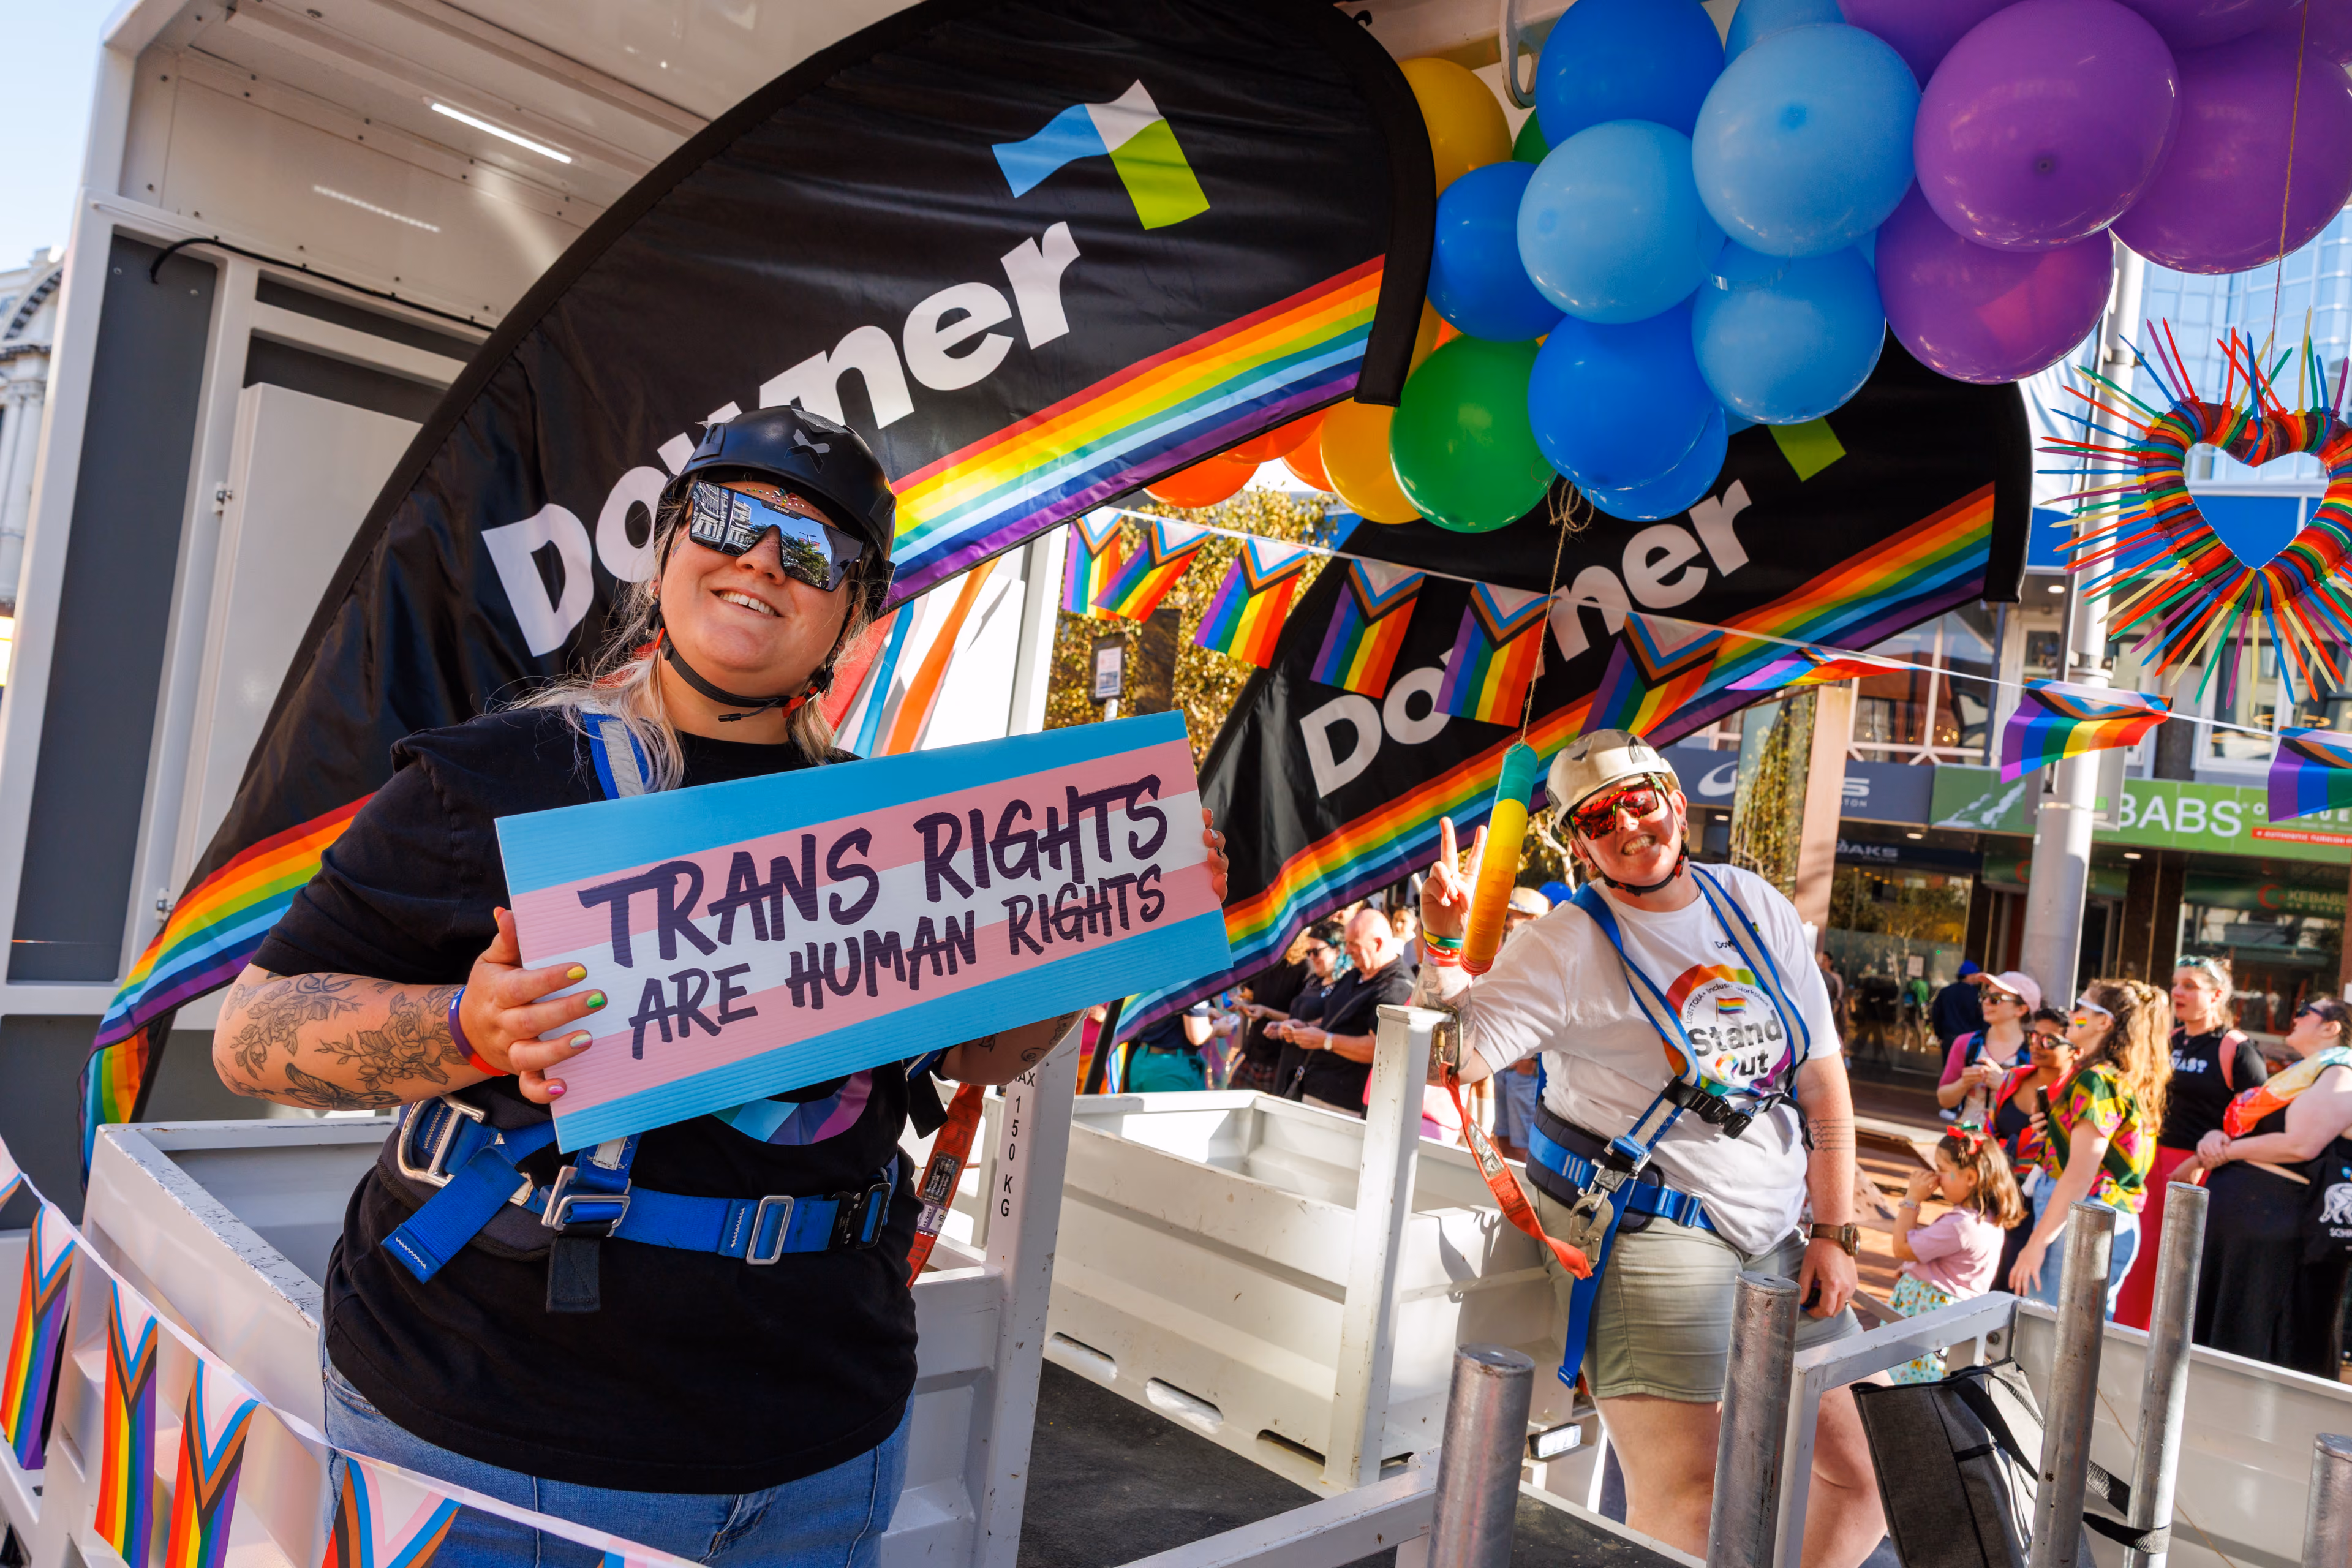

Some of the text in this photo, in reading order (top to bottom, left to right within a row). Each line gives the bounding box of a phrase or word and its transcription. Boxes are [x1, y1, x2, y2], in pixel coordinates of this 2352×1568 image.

[481, 221, 1081, 657] Doner
[1299, 478, 1752, 799] Doner
[576, 773, 1169, 968] TRANS RIGHTS
[2120, 793, 2242, 837] BABS
[628, 864, 1166, 1060] ARE HUMAN RIGHTS
[1687, 1009, 1783, 1057] Stand
[1014, 1071, 1036, 1087] AX
